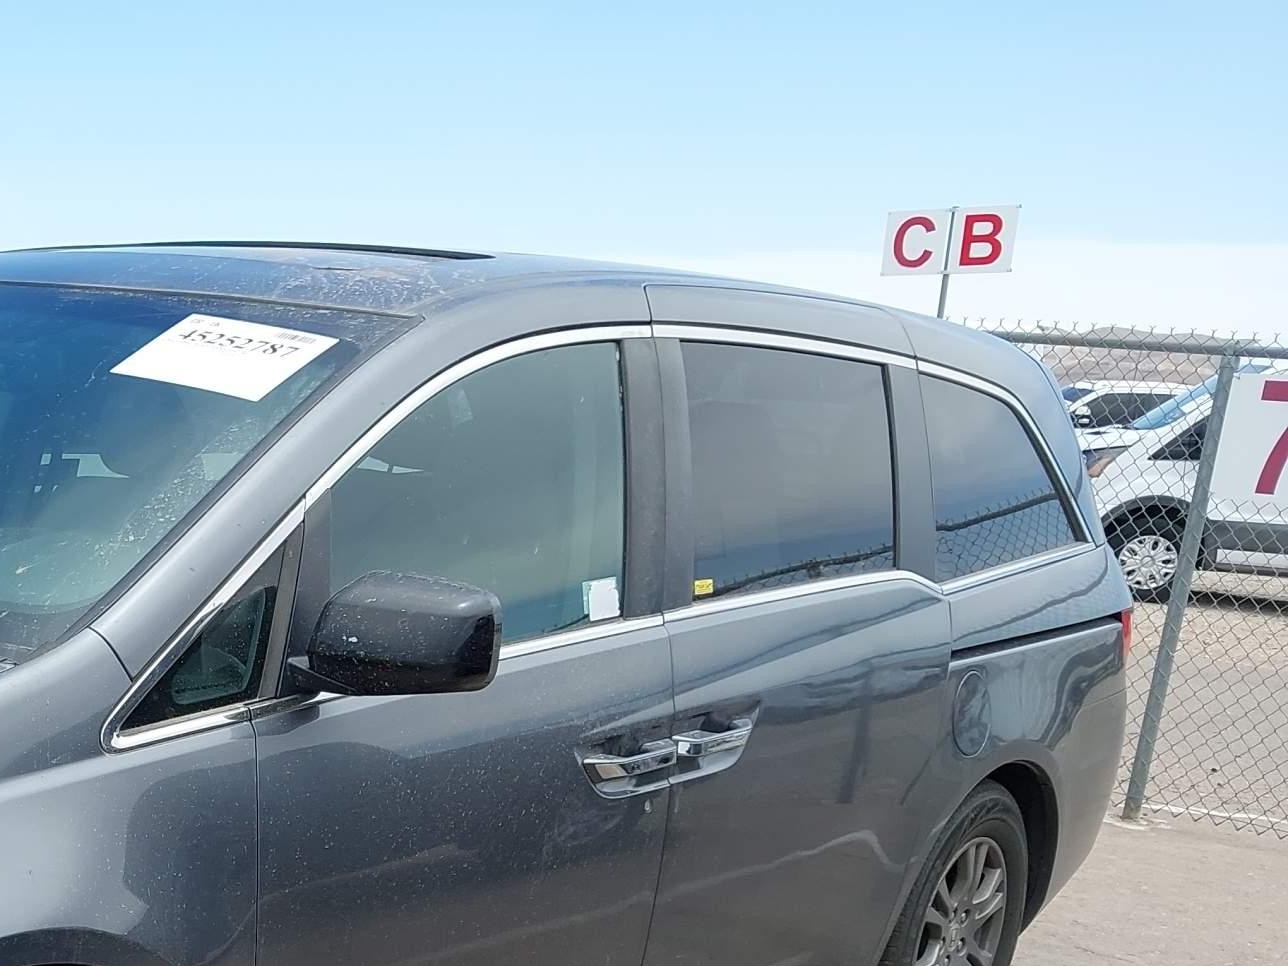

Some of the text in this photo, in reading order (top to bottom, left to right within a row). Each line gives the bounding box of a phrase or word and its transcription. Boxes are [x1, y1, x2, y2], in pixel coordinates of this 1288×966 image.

[893, 216, 936, 268] C
[959, 213, 1004, 266] B
[178, 329, 300, 358] 45252787
